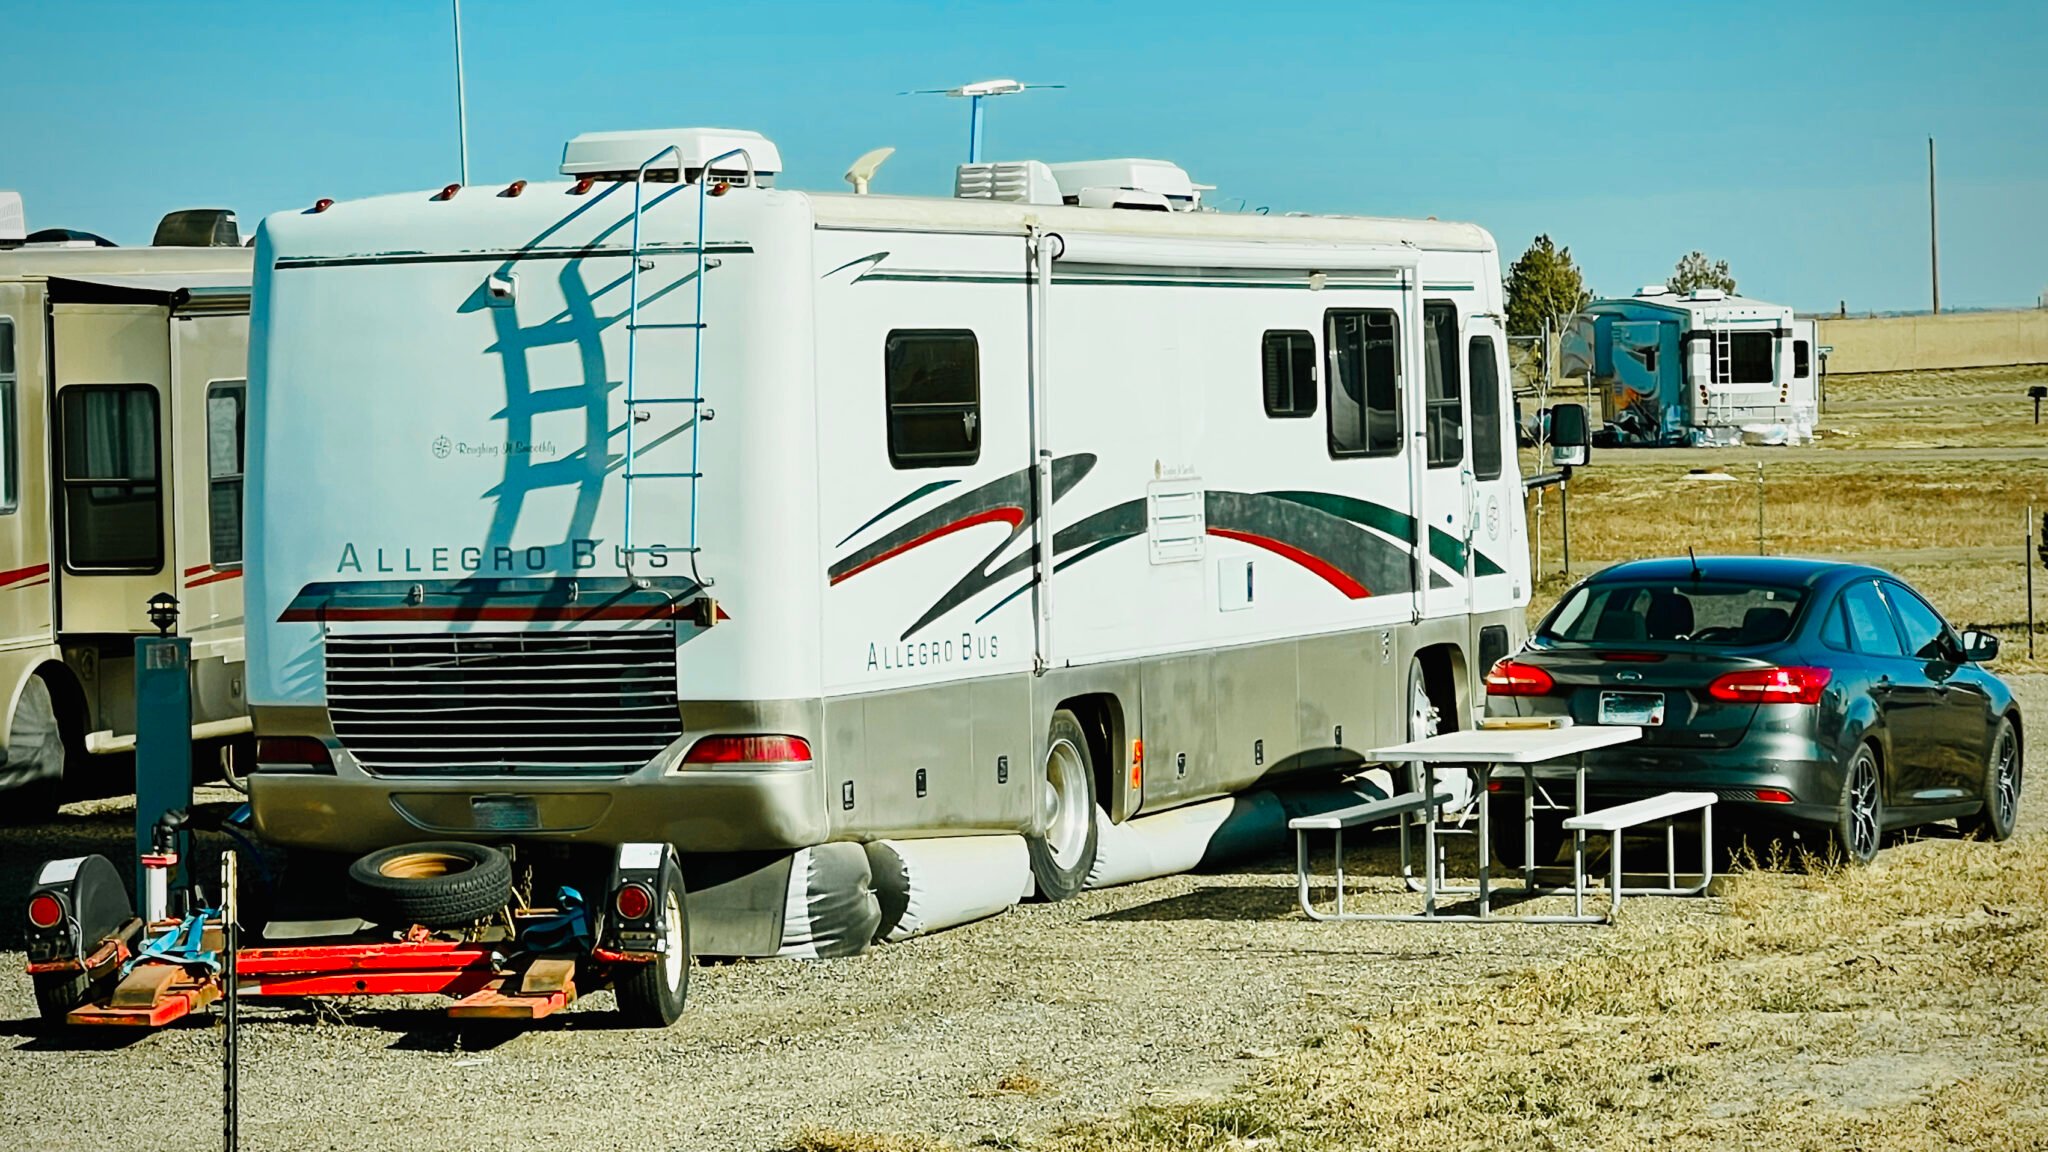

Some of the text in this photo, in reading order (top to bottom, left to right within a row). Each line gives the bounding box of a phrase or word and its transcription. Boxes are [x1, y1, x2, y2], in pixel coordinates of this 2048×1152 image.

[337, 538, 669, 573] ALLEGRO BUS
[867, 632, 998, 671] ALLEGRO BUS
